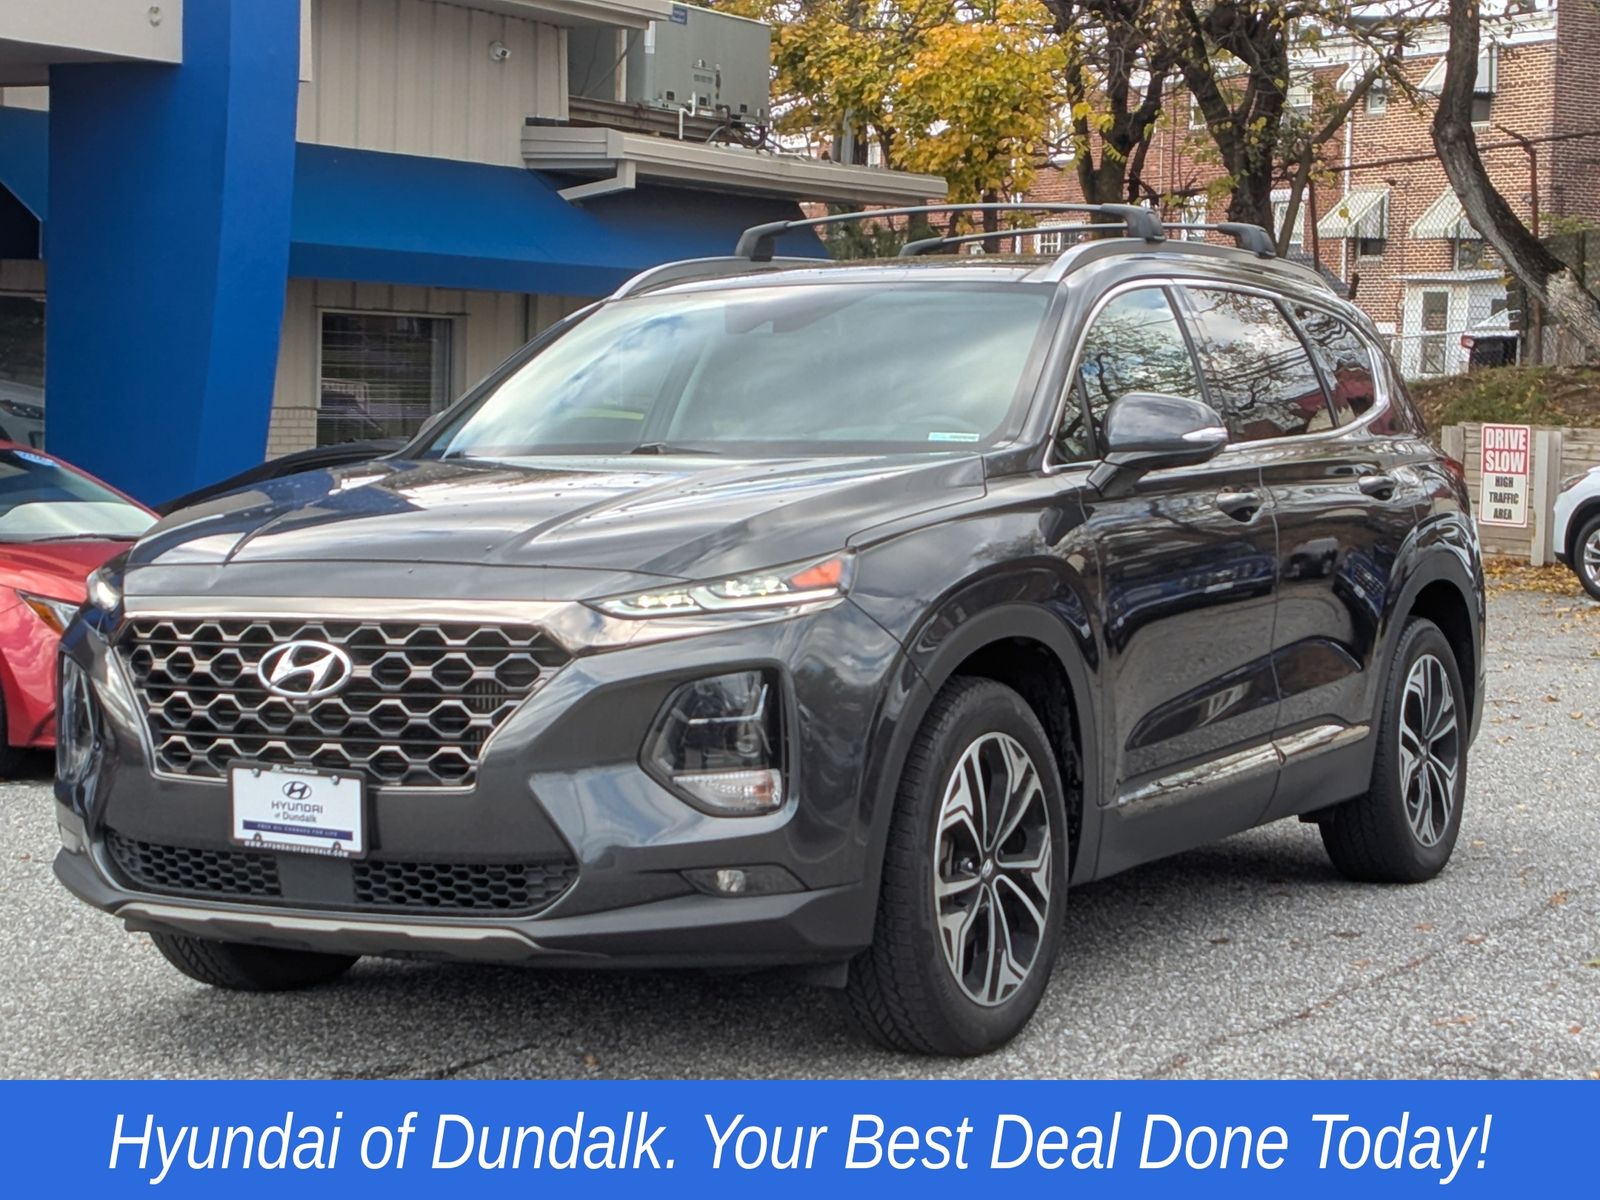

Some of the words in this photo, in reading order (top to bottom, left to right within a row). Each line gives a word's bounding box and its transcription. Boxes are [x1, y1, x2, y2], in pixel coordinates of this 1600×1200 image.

[1485, 428, 1526, 450] DRIVE
[1485, 450, 1525, 472] SLOW
[1495, 476, 1514, 487] HIGH
[1489, 491, 1519, 504] TRAFFIC
[1493, 508, 1512, 520] AREA
[271, 801, 323, 813] HYUNDAI
[282, 811, 317, 823] Dundalk
